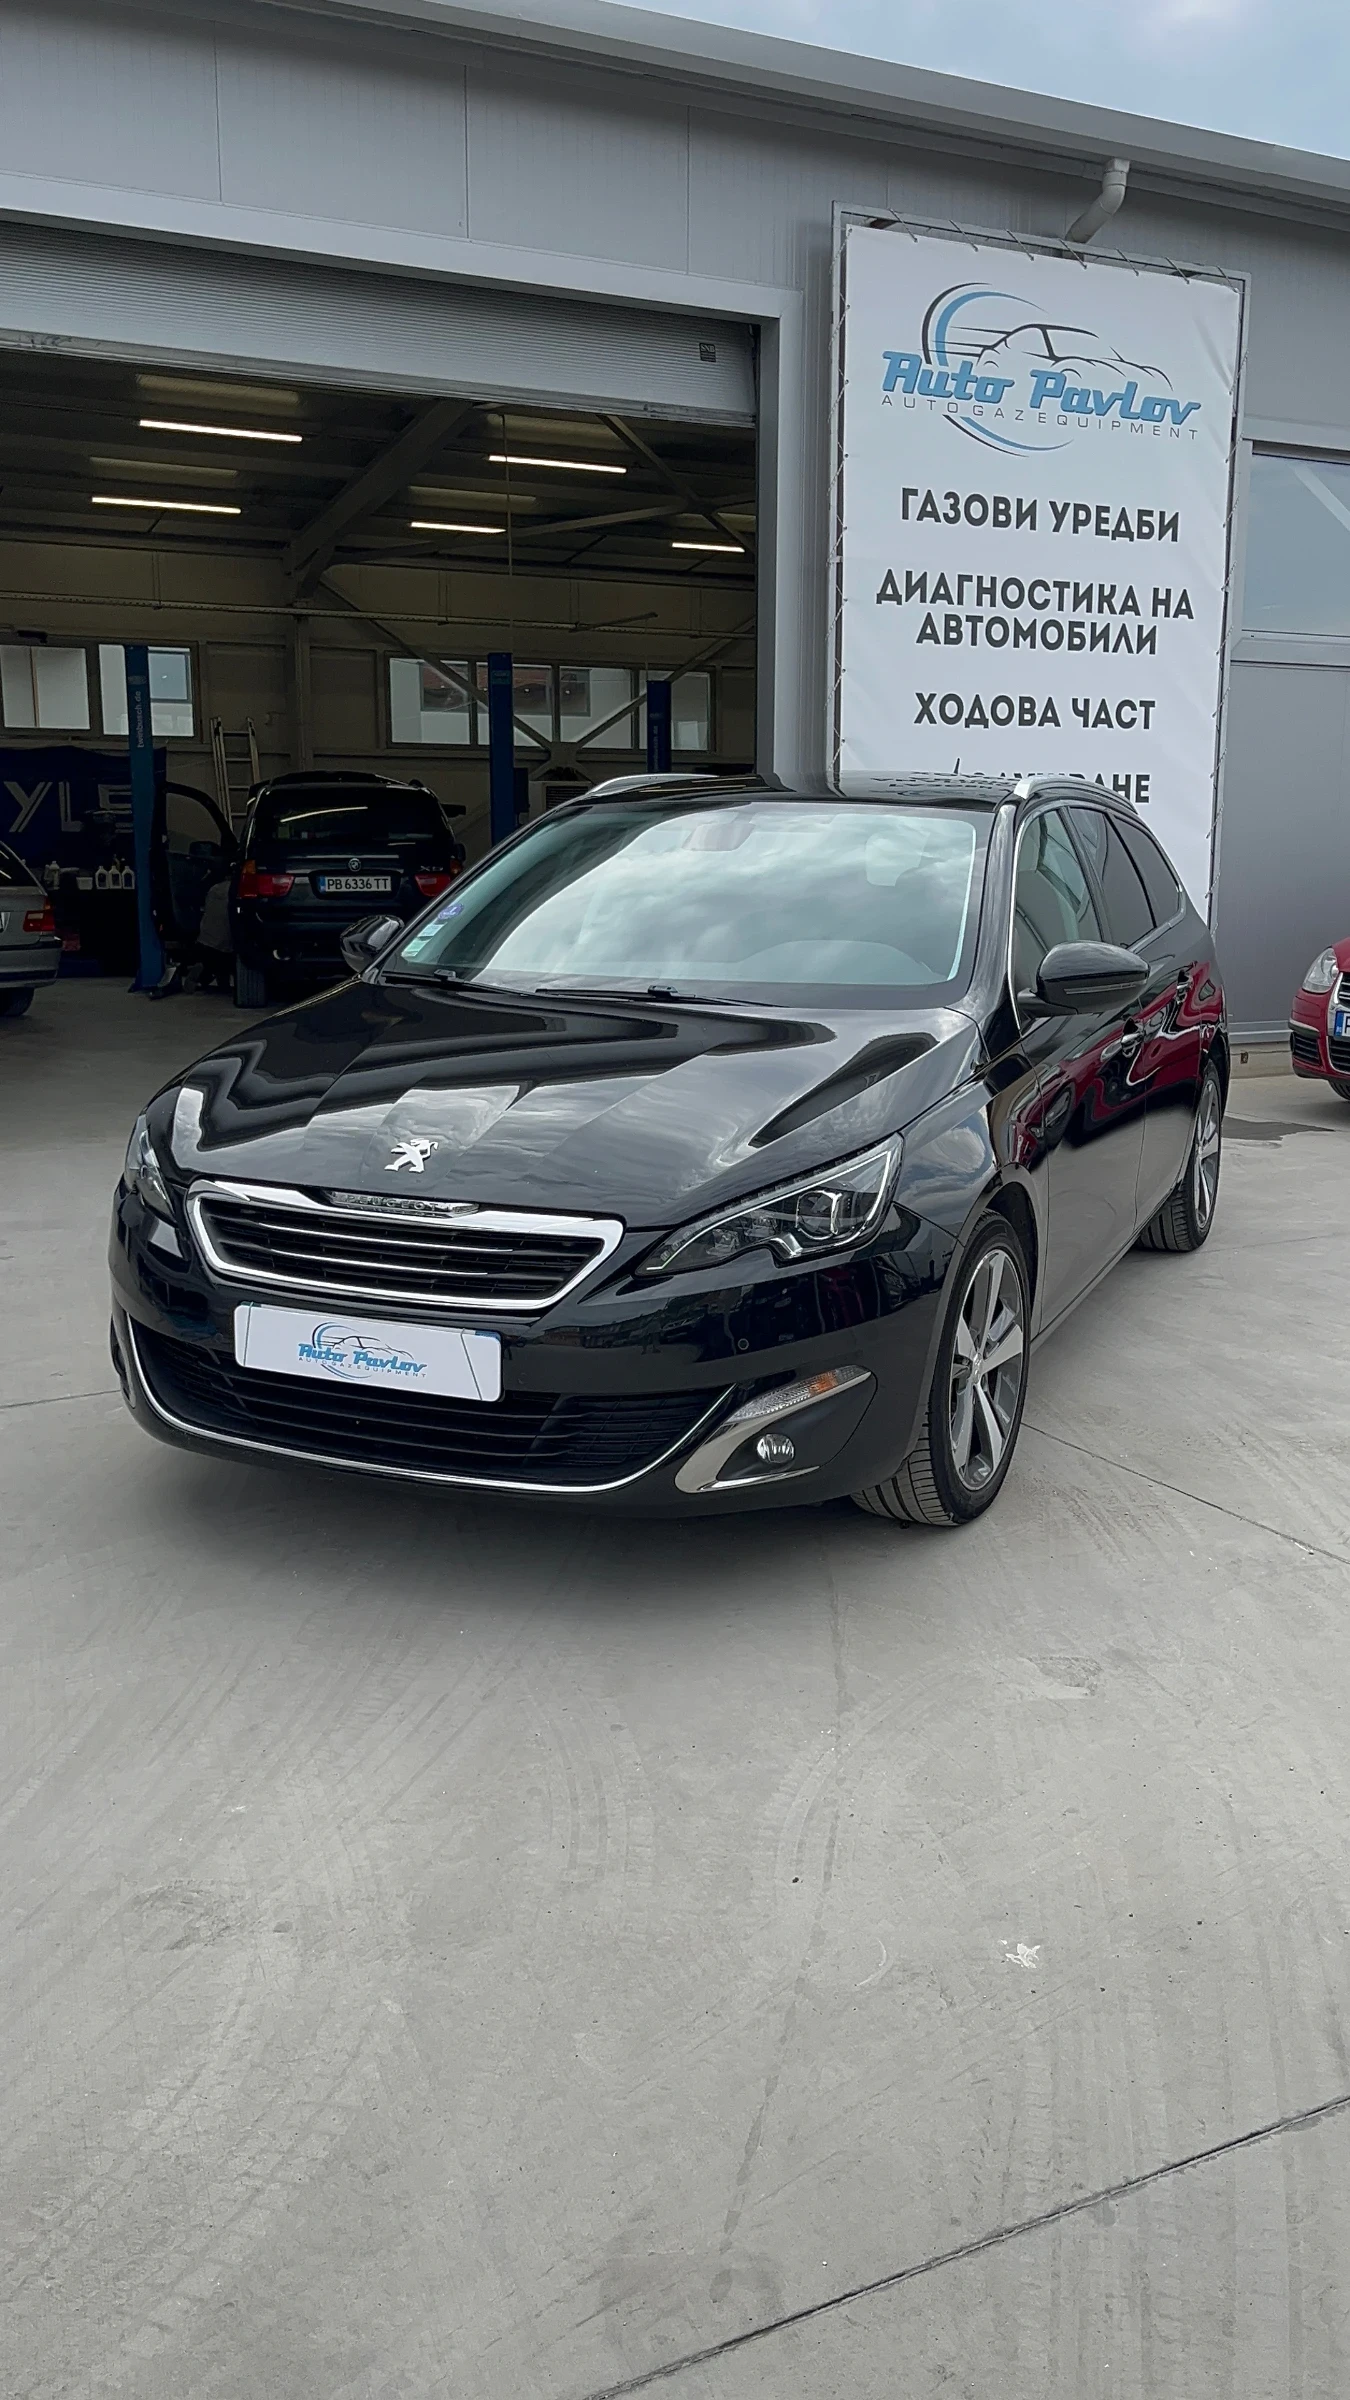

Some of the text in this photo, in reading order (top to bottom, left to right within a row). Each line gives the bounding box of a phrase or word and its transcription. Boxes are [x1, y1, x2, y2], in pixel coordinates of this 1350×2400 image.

[882, 350, 1202, 426] Auto Pavlov
[901, 487, 1179, 543] ГАЗОВИ УРЕДБИ
[875, 568, 1194, 620] ДИАГНОСТИКА НА
[915, 611, 1157, 656] АВТОМОБИЛИ
[913, 692, 1156, 730] ХОДОВА ЧАСТ
[327, 878, 343, 890] PB
[344, 878, 372, 890] 6336
[374, 878, 389, 890] TT
[298, 1343, 348, 1362] Auto
